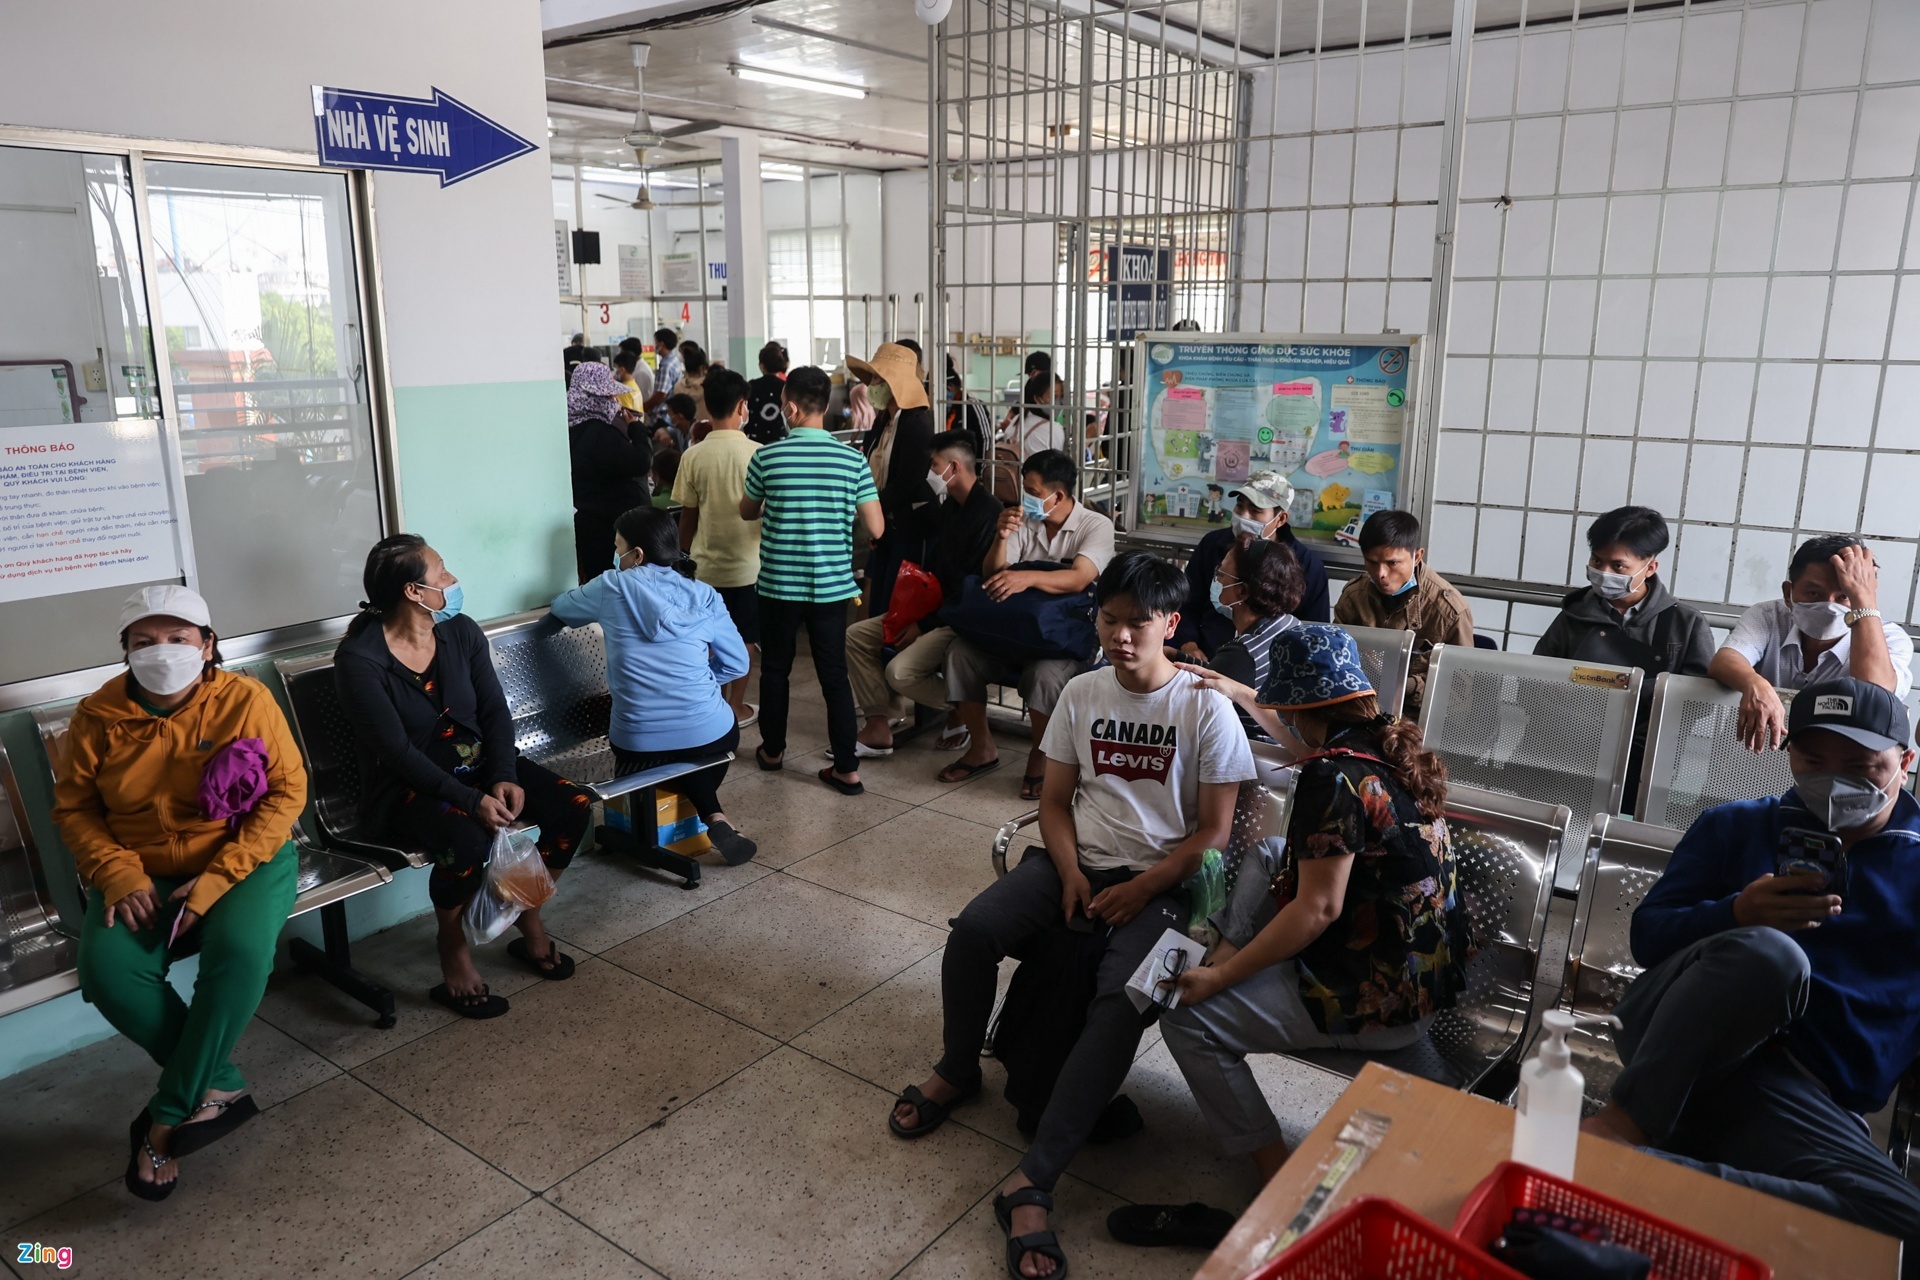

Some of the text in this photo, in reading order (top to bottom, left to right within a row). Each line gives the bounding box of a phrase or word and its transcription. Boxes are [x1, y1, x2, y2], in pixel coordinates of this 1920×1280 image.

[326, 102, 450, 161] NHÀ VỆ SINH
[709, 262, 727, 280] THU
[1122, 255, 1154, 281] KHOA
[600, 303, 610, 324] 3
[681, 302, 690, 323] 4
[1179, 344, 1214, 354] TRUYỀN
[1216, 345, 1248, 354] THÔNG
[1251, 346, 1274, 355] GIÁO
[1277, 348, 1297, 357] DỤC
[1300, 346, 1320, 356] SỨC
[5, 442, 75, 455] THÔNG BÁO
[4, 479, 19, 487] QUÝ
[1091, 718, 1177, 747] CANADA
